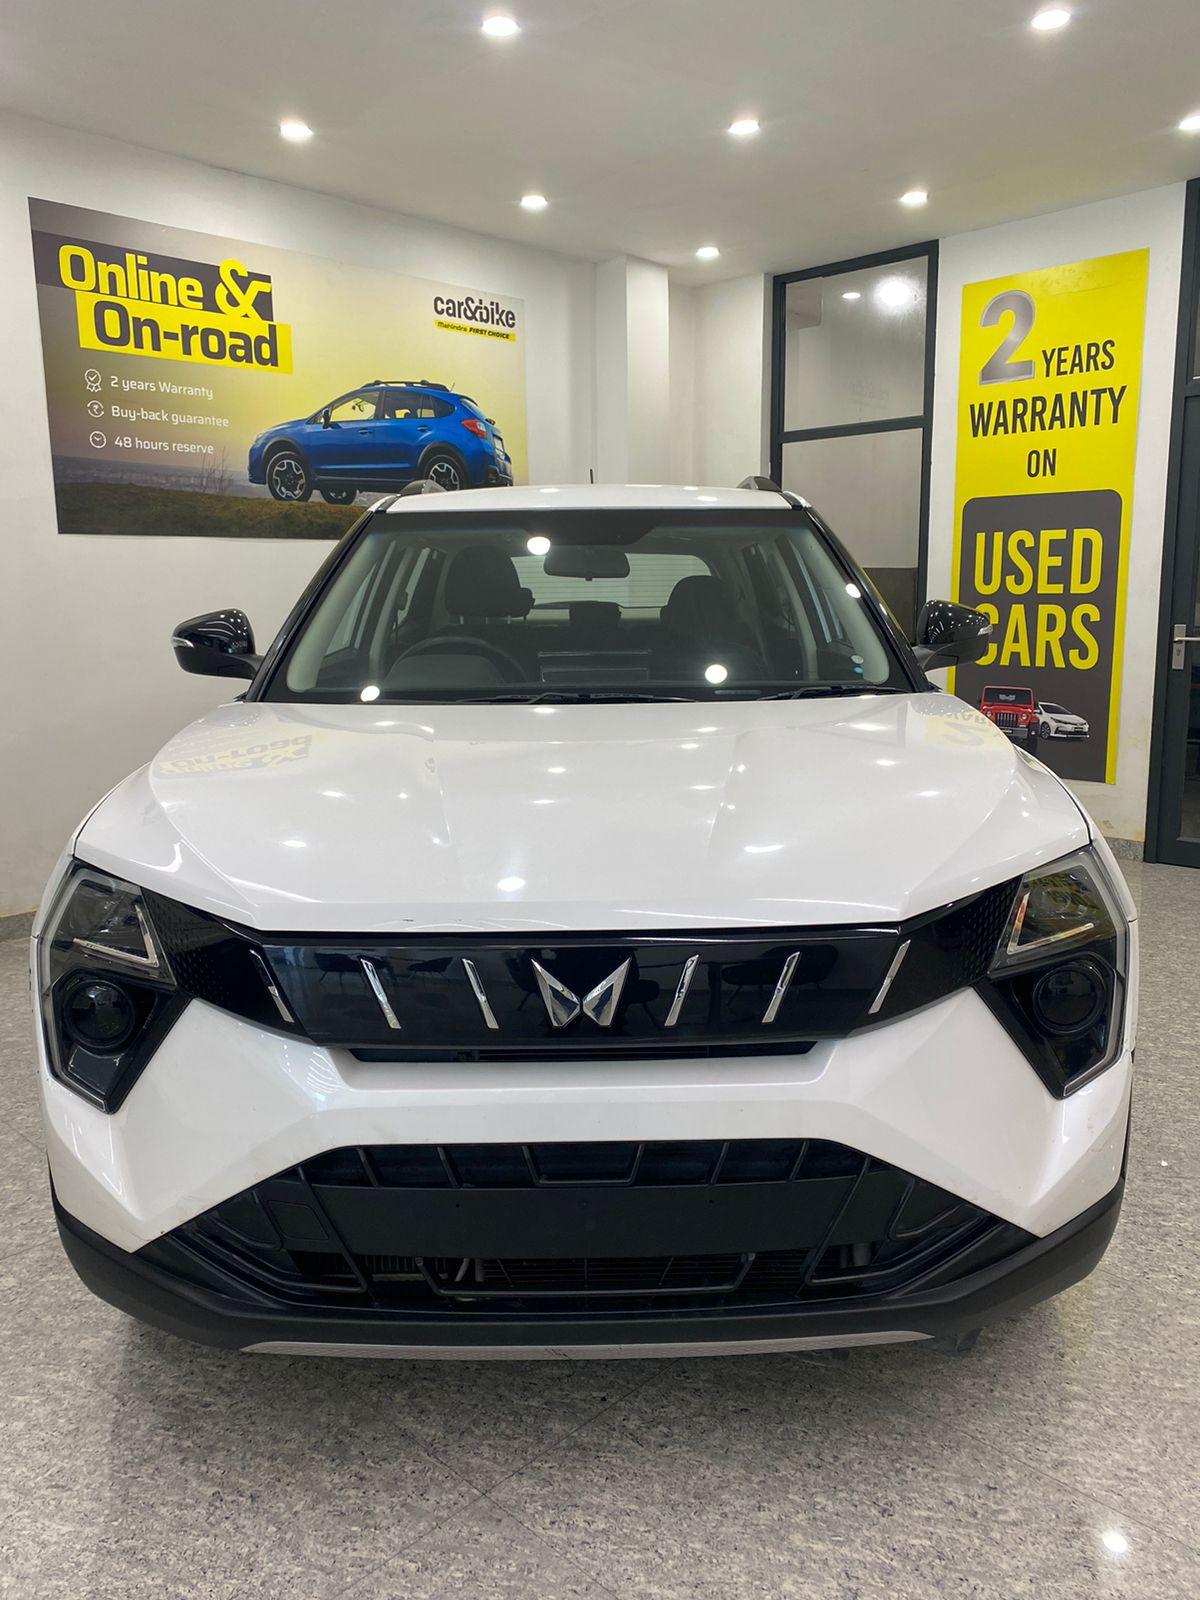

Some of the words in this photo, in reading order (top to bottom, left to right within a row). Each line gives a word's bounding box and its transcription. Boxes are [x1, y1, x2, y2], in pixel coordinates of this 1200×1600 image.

[59, 245, 203, 309] Online
[215, 259, 272, 320] &
[433, 296, 516, 328] car&bike
[94, 300, 279, 368] On-road
[469, 327, 487, 336] FIRST
[488, 330, 510, 340] CHOICE
[979, 289, 1036, 386] 2
[1042, 339, 1116, 378] YEARS
[110, 375, 119, 388] 2
[121, 379, 156, 392] years
[158, 381, 214, 400] Warranty
[111, 405, 169, 421] Buy-back
[171, 414, 230, 427] guarantee
[969, 385, 1128, 439] WARRANTY
[114, 436, 132, 449] 48
[135, 437, 170, 451] hours
[172, 443, 215, 455] reserve
[1026, 448, 1057, 478] ON
[973, 527, 1104, 596] USED
